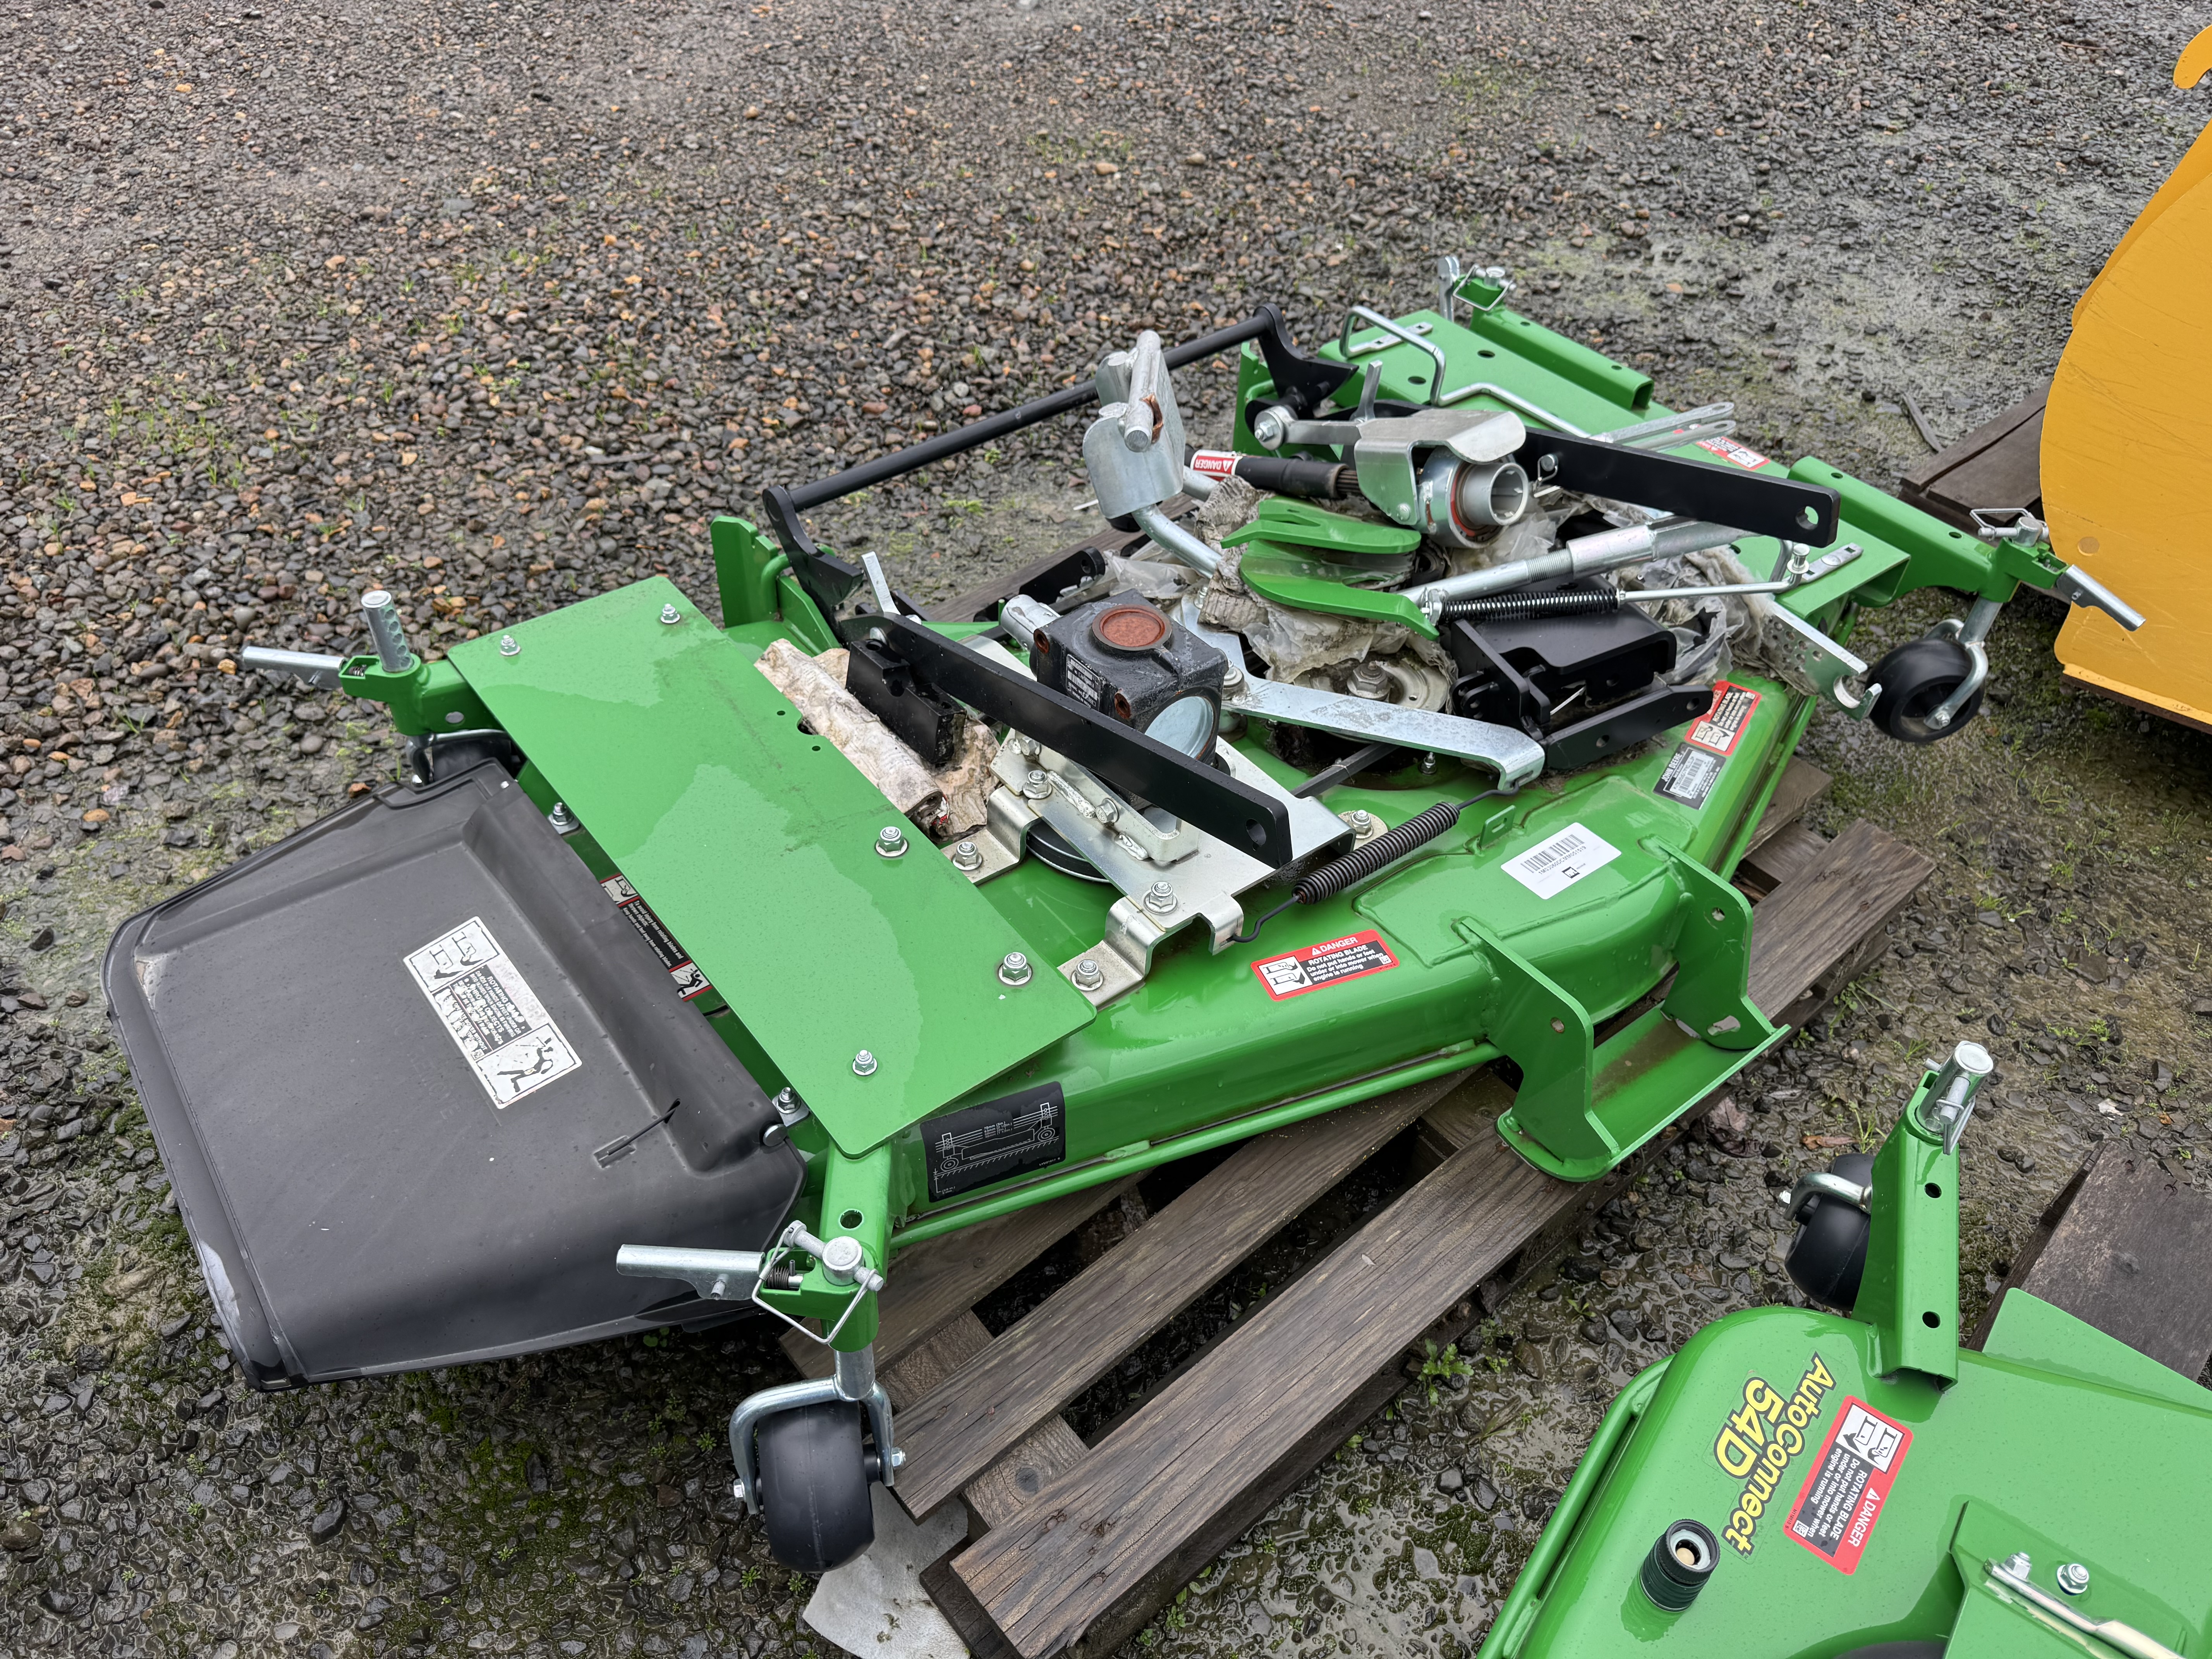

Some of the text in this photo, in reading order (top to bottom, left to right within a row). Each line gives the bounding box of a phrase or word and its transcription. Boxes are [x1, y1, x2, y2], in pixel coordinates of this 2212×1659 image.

[1195, 459, 1222, 470] DANGER
[1661, 753, 1682, 782] JOHN DEERE
[1308, 945, 1368, 965] ROTATING BLADE
[1320, 937, 1358, 952] DANGER
[1310, 969, 1327, 977] under
[1347, 957, 1367, 966] mower
[1313, 972, 1333, 981] engine
[1340, 964, 1364, 974] running
[1337, 955, 1356, 963] hands
[487, 976, 508, 1003] ROTATING
[474, 1033, 488, 1050] WITHOUT
[1715, 1378, 1787, 1477] 54D
[1723, 1353, 1835, 1554] AutoConnect
[1828, 1448, 1842, 1470] engine
[1807, 1453, 1850, 1537] under or into mower when
[1811, 1477, 1828, 1504] running
[1819, 1458, 1860, 1537] Do not put hands or feet
[1830, 1470, 1867, 1540] ROTATING BLADE
[1848, 1501, 1876, 1547] DANGER
